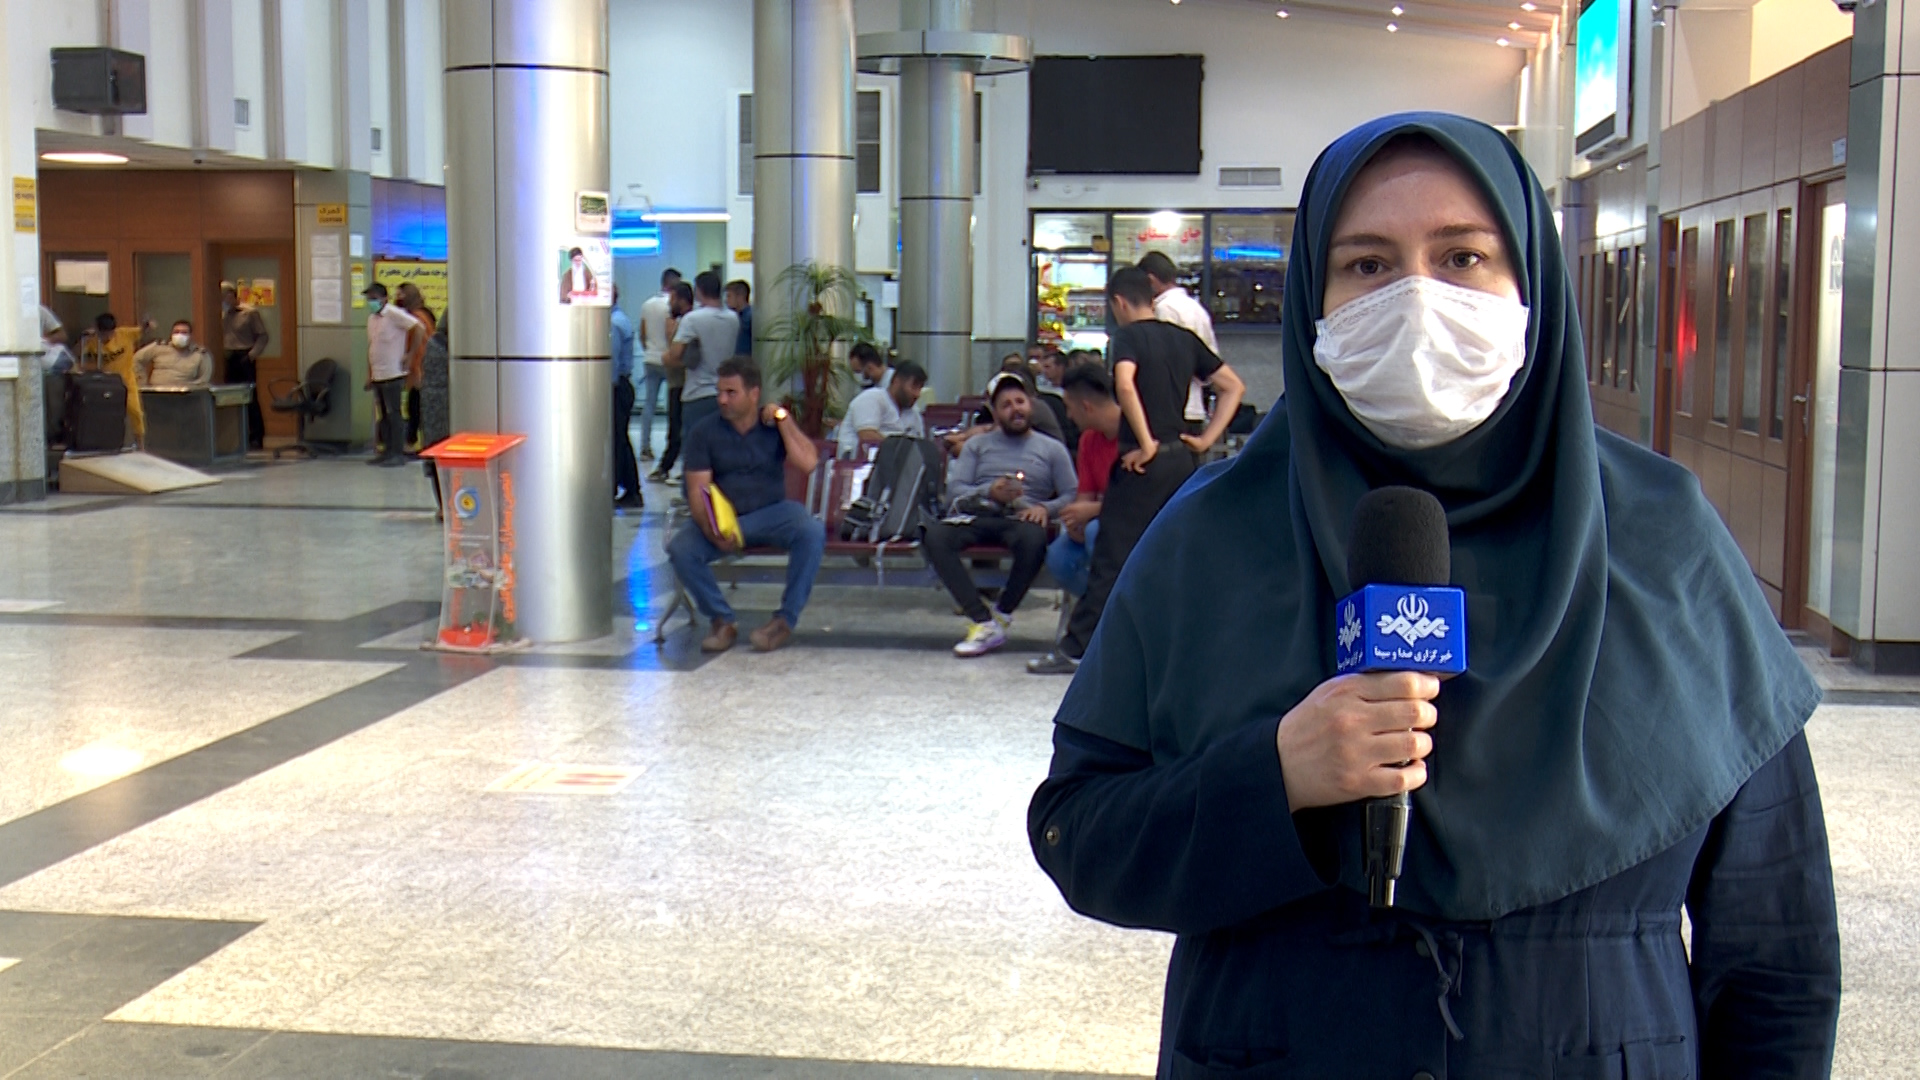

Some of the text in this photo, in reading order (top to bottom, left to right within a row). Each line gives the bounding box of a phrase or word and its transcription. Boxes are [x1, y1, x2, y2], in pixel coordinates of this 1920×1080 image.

[1374, 646, 1391, 660] سیما
[1393, 651, 1397, 661] و
[1398, 647, 1413, 659] صدا
